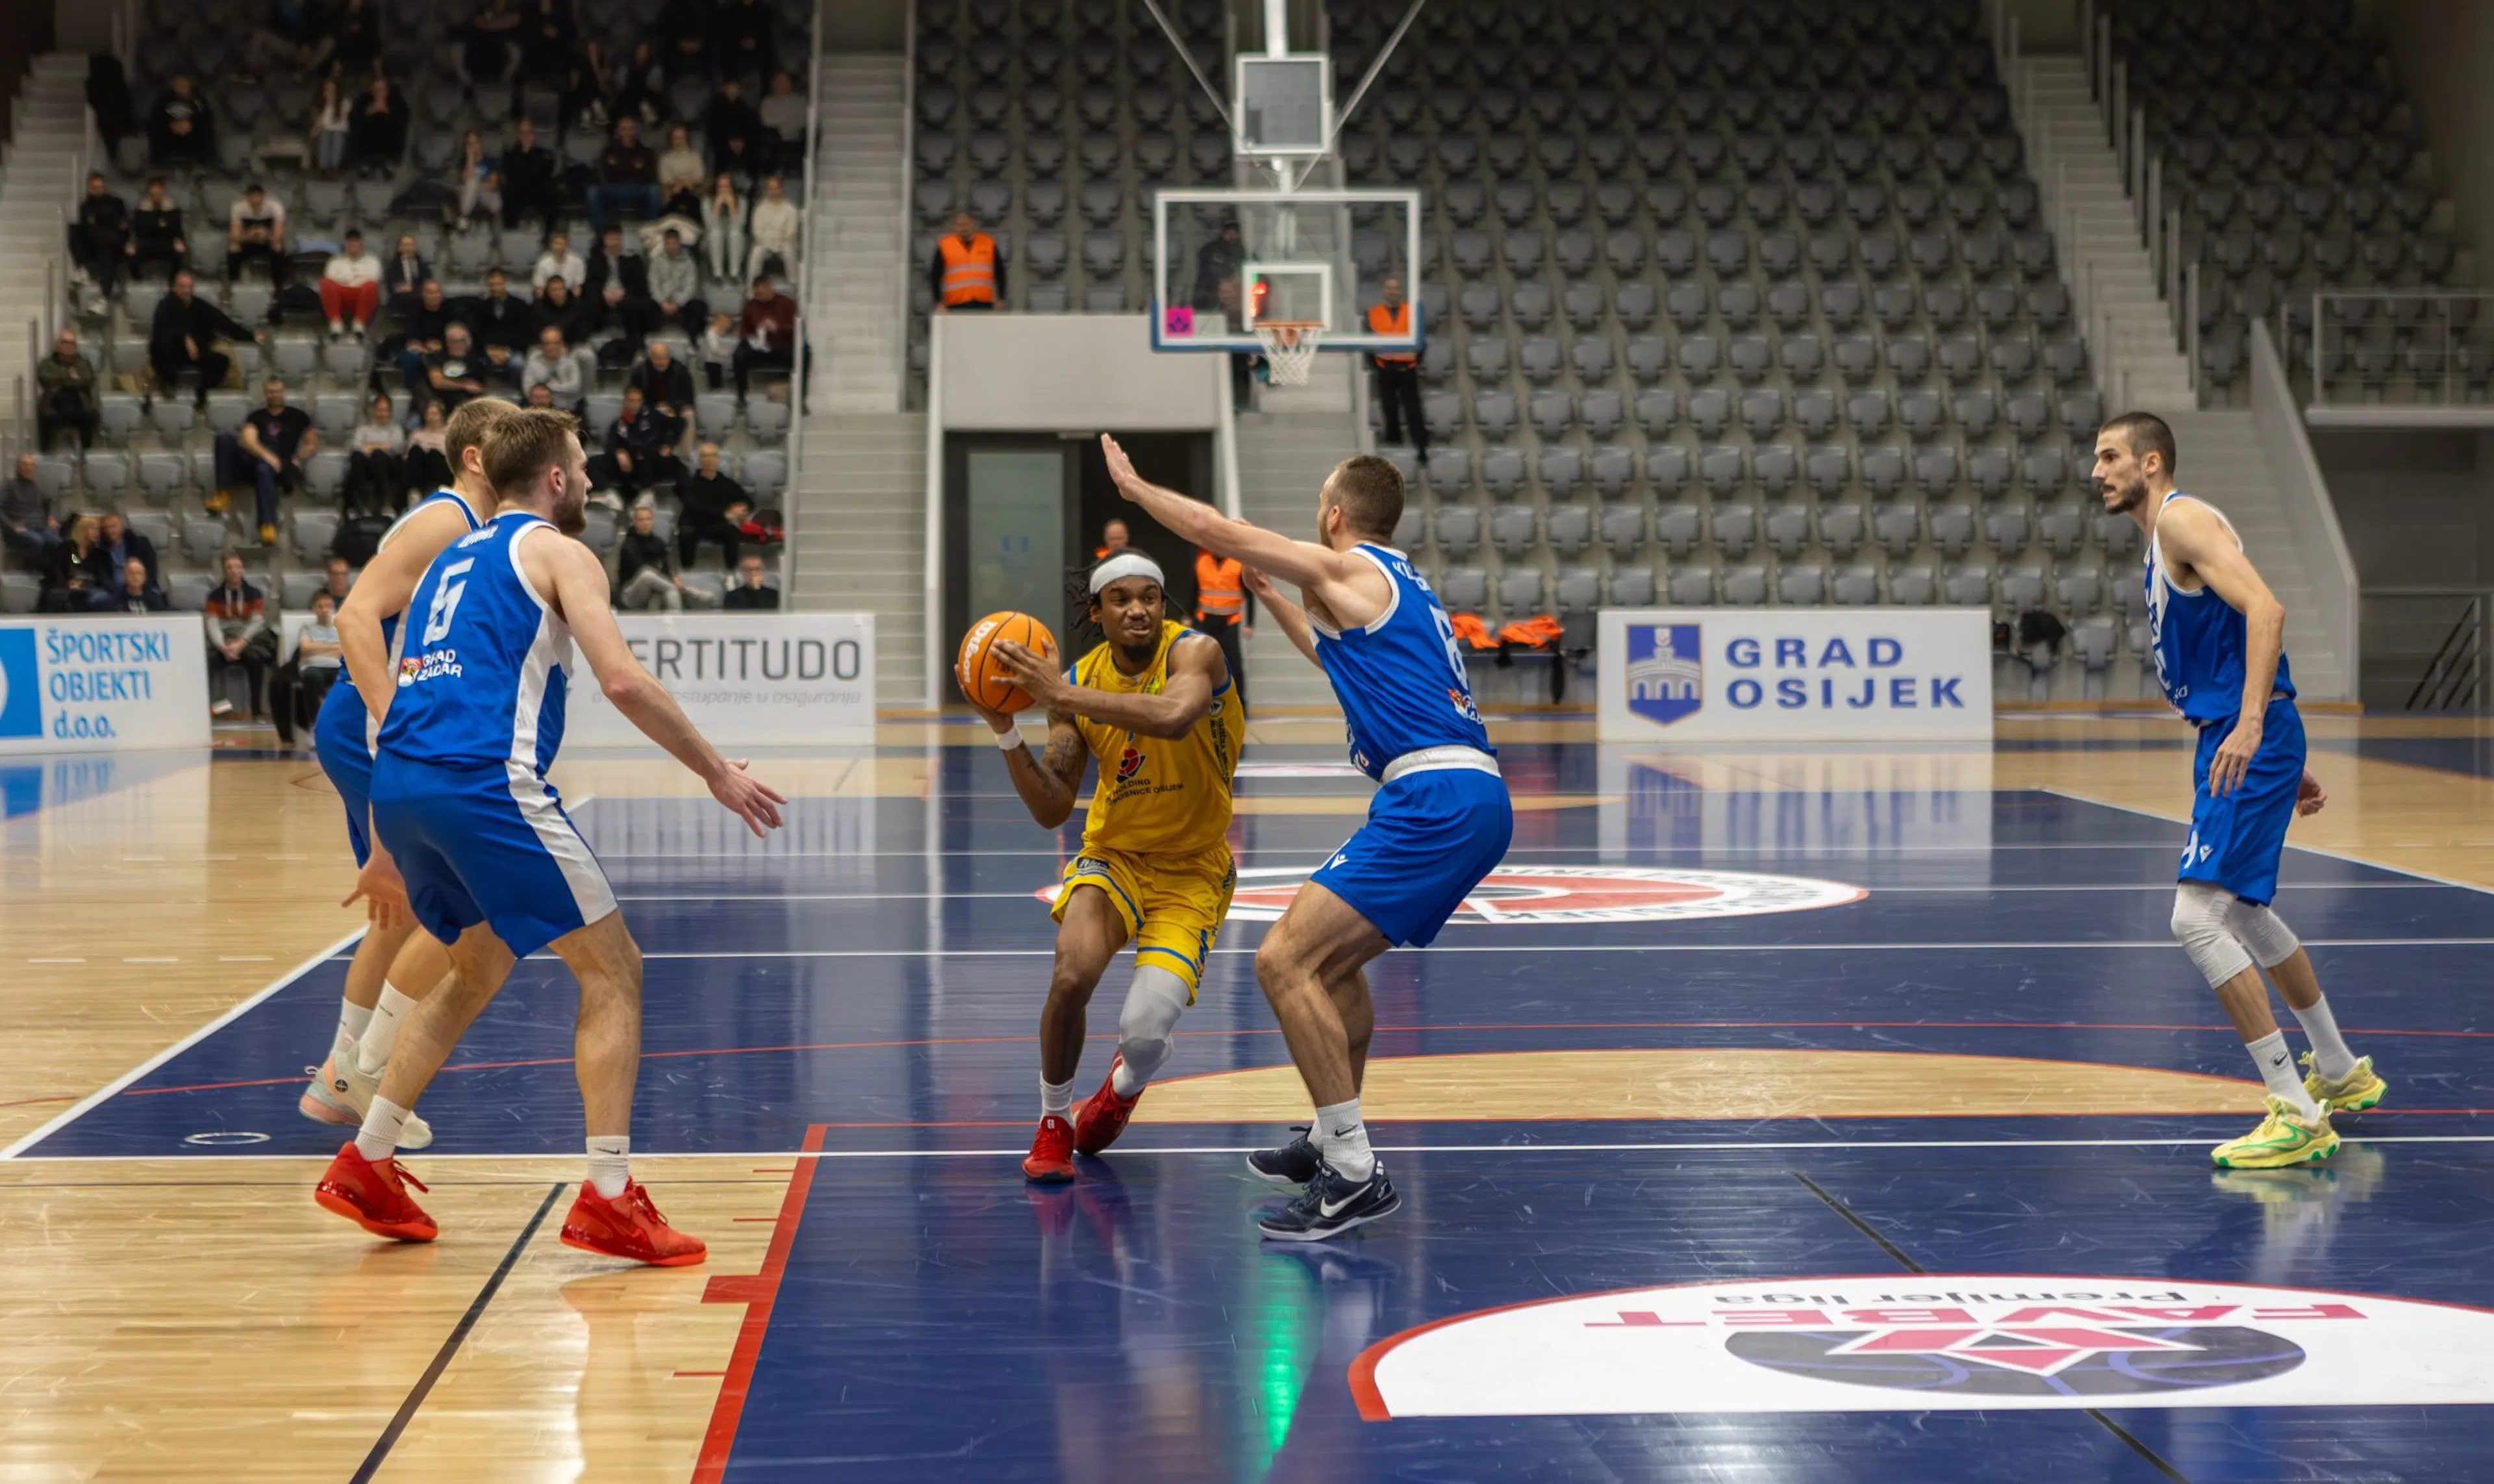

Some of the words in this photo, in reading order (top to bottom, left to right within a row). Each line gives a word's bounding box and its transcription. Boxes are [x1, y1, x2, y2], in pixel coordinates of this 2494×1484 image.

[46, 627, 170, 665] ŠPORTSKI
[423, 649, 456, 668] GRAD
[627, 638, 861, 681] RTITUDO
[1725, 636, 1904, 669] GRAD
[49, 670, 151, 702] OBJEKTI
[417, 662, 463, 681] ZADAR
[1725, 677, 1966, 710] OSIJEK
[53, 707, 118, 739] d.o.o.
[1583, 1304, 2369, 1327] FAVBET
[1714, 1294, 1851, 1305] liga
